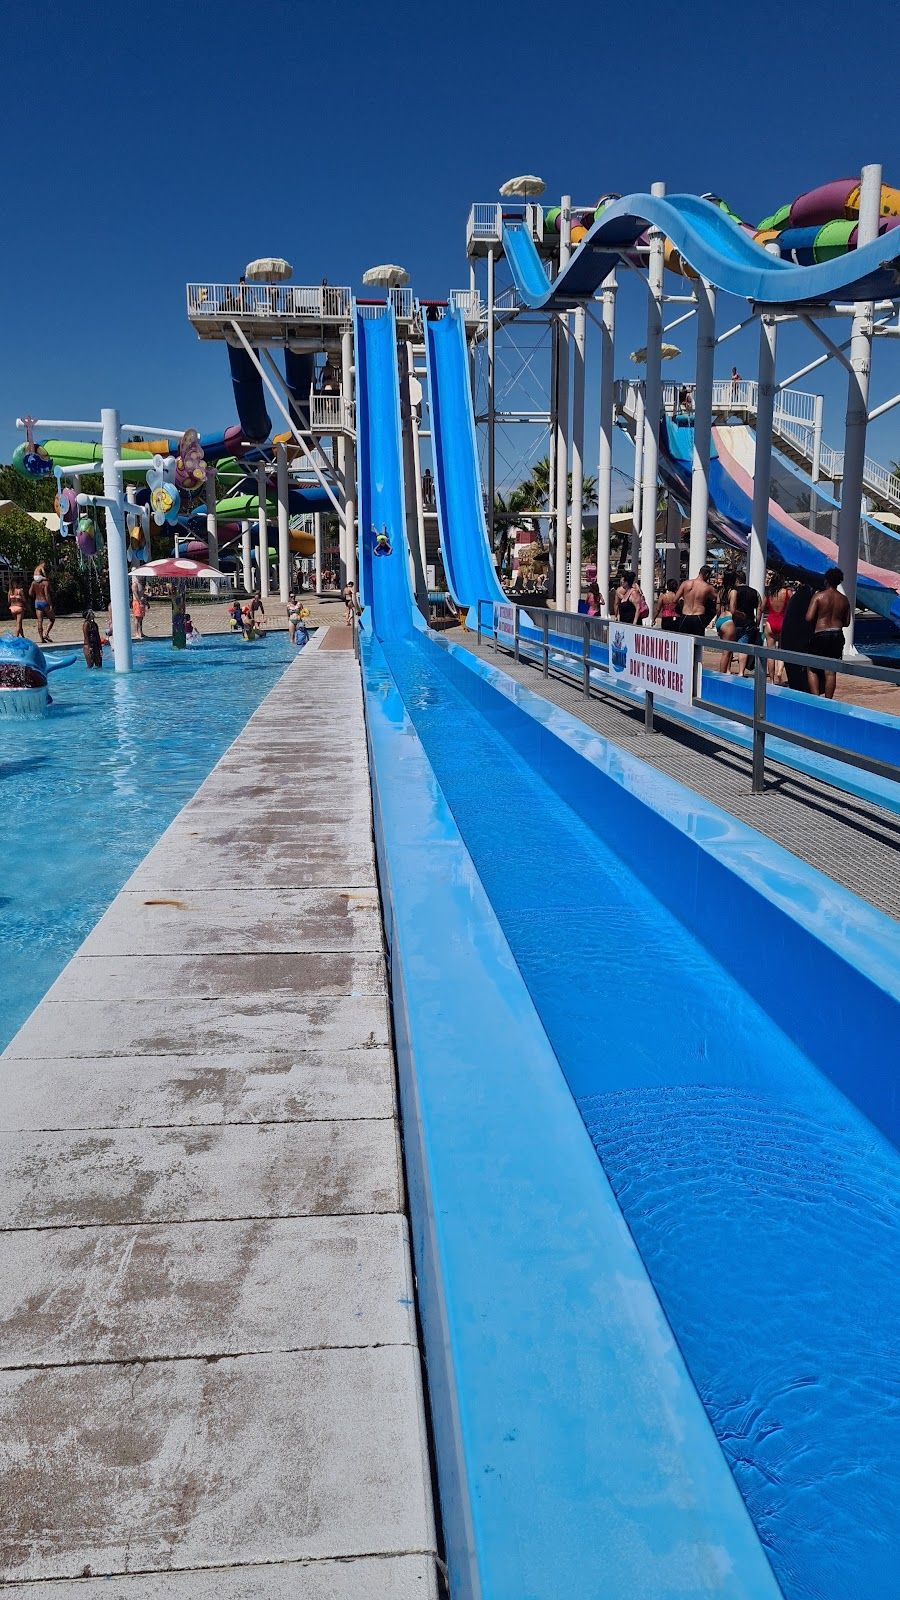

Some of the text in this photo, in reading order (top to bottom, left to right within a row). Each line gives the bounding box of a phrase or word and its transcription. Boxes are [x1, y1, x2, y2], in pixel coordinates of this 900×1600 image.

[634, 633, 678, 664] WARNING!!!
[630, 658, 684, 693] DON'T CROSS HERE
